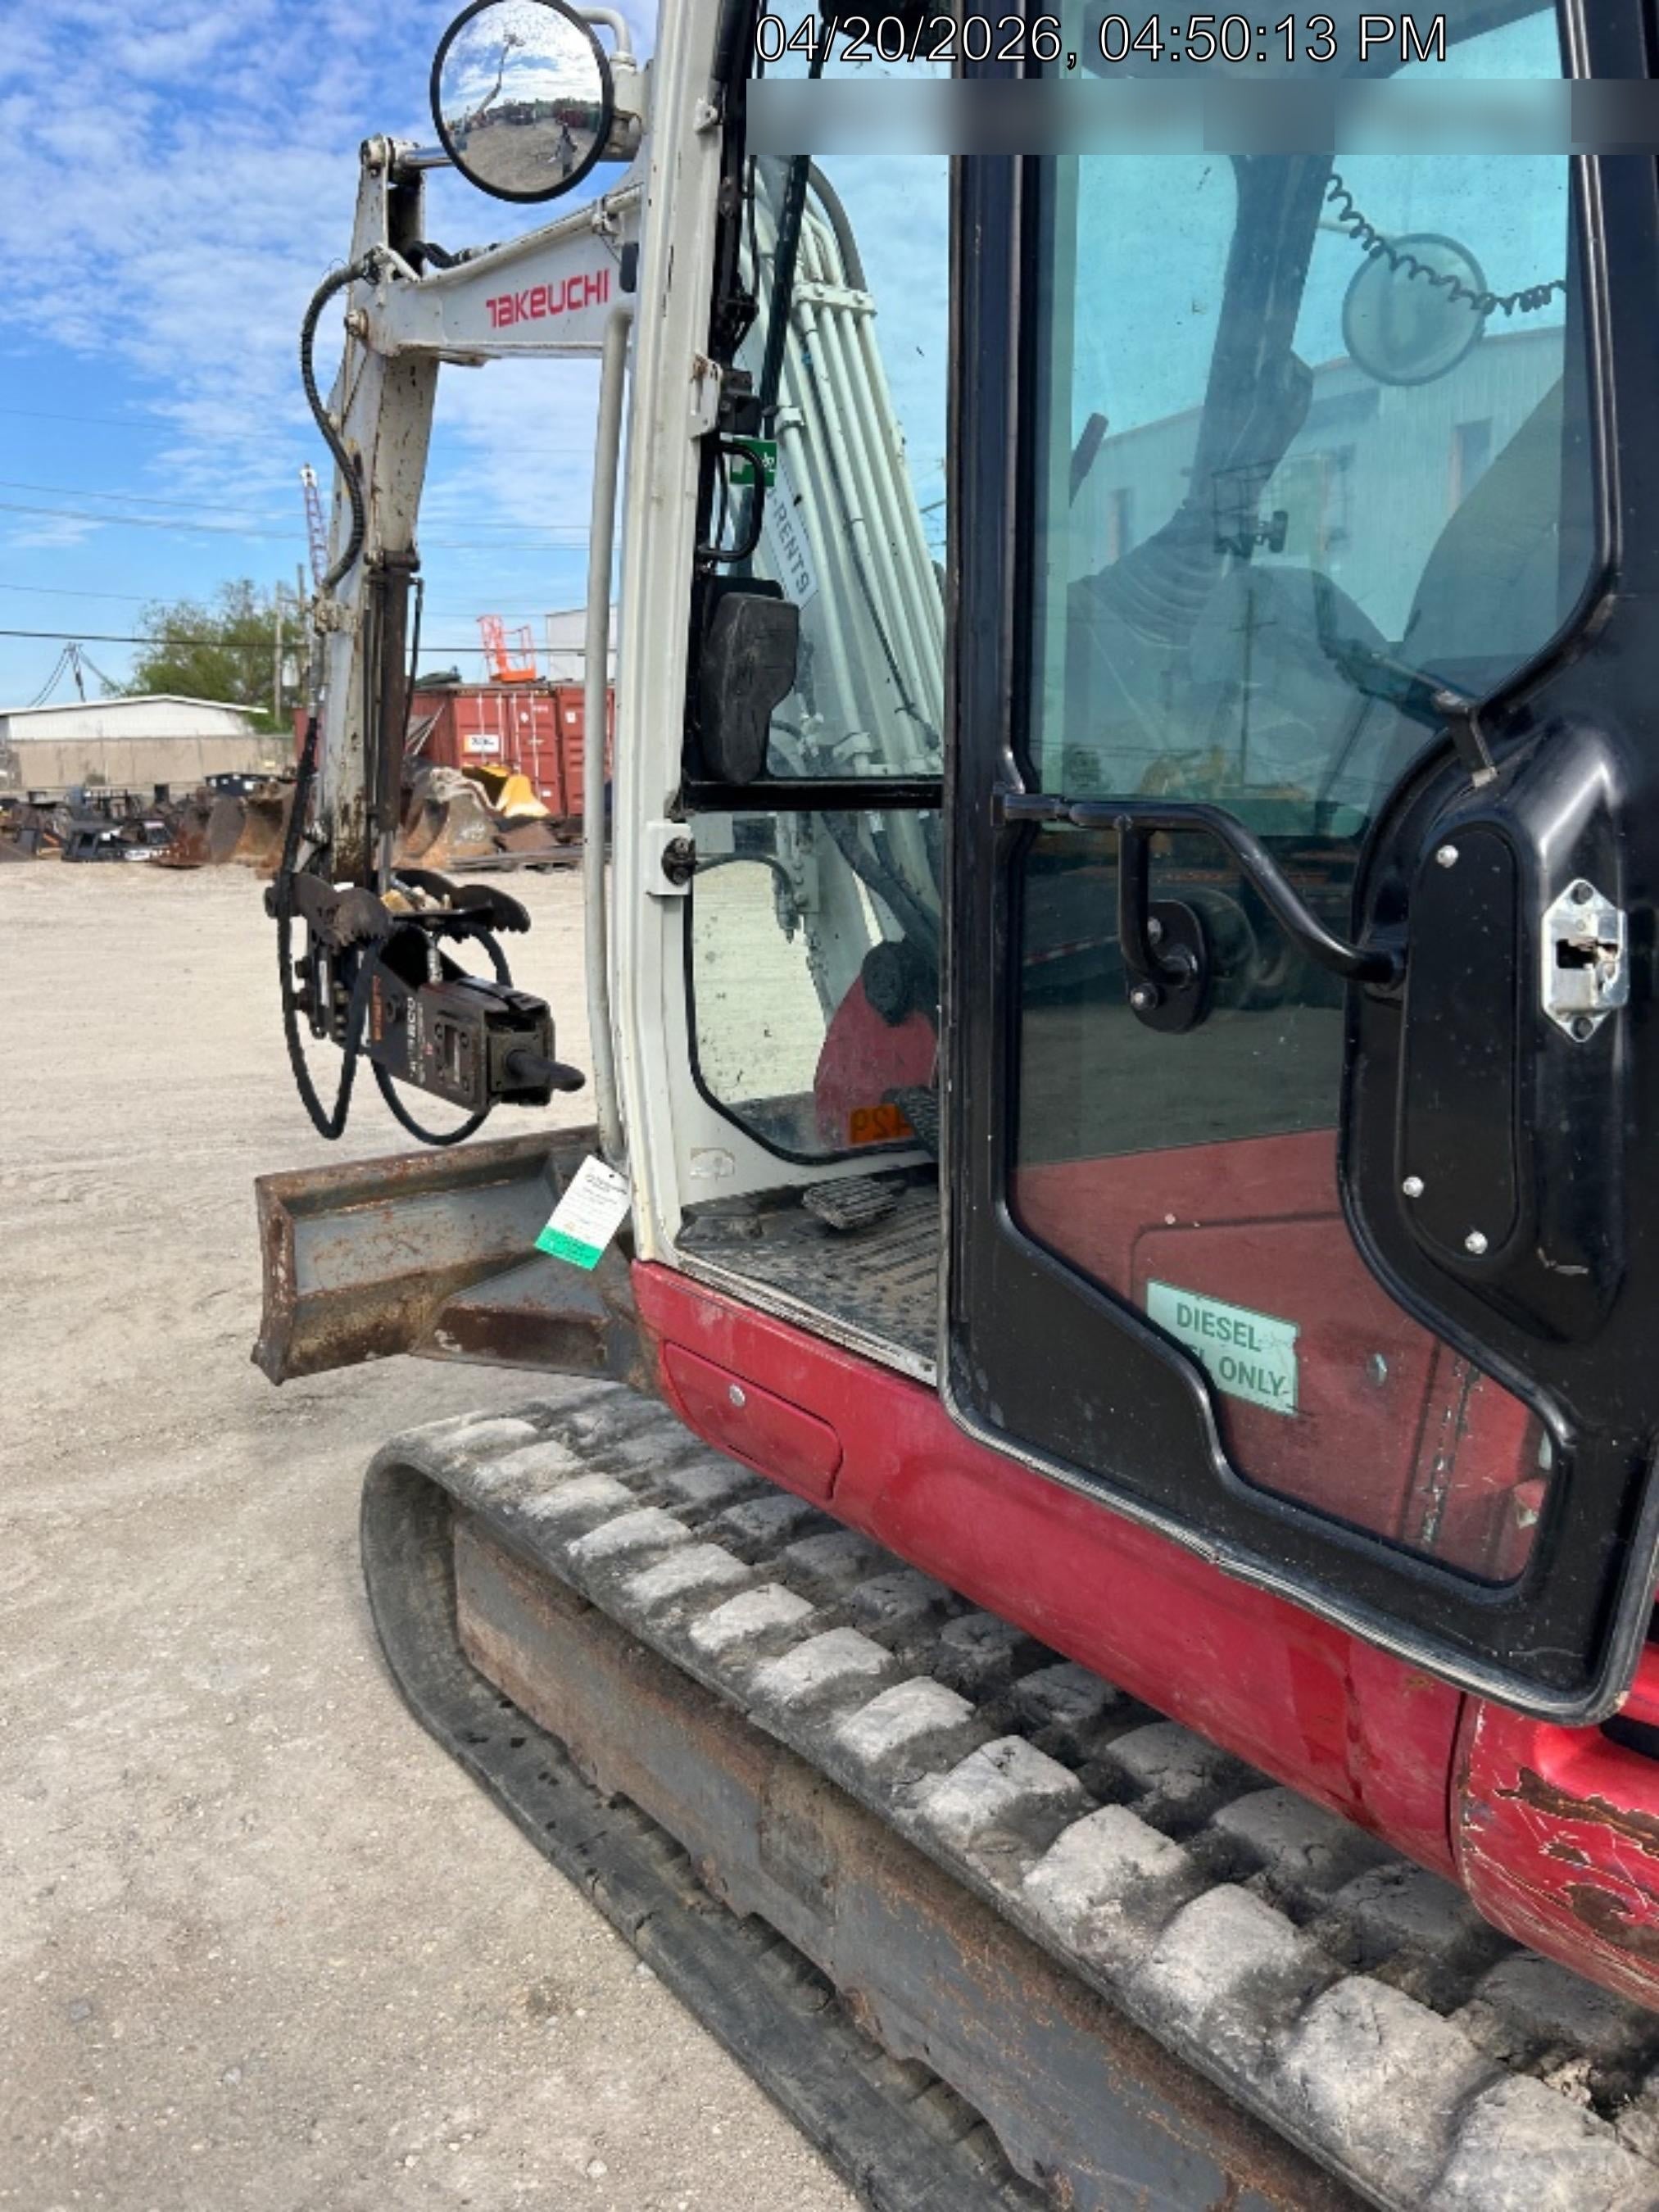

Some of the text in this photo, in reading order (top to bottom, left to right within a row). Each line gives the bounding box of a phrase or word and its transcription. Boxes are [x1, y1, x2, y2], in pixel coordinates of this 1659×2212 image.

[486, 268, 610, 328] TAKEUCHI
[1176, 1302, 1262, 1353] DIESEL
[1218, 1356, 1286, 1397] ONLY
